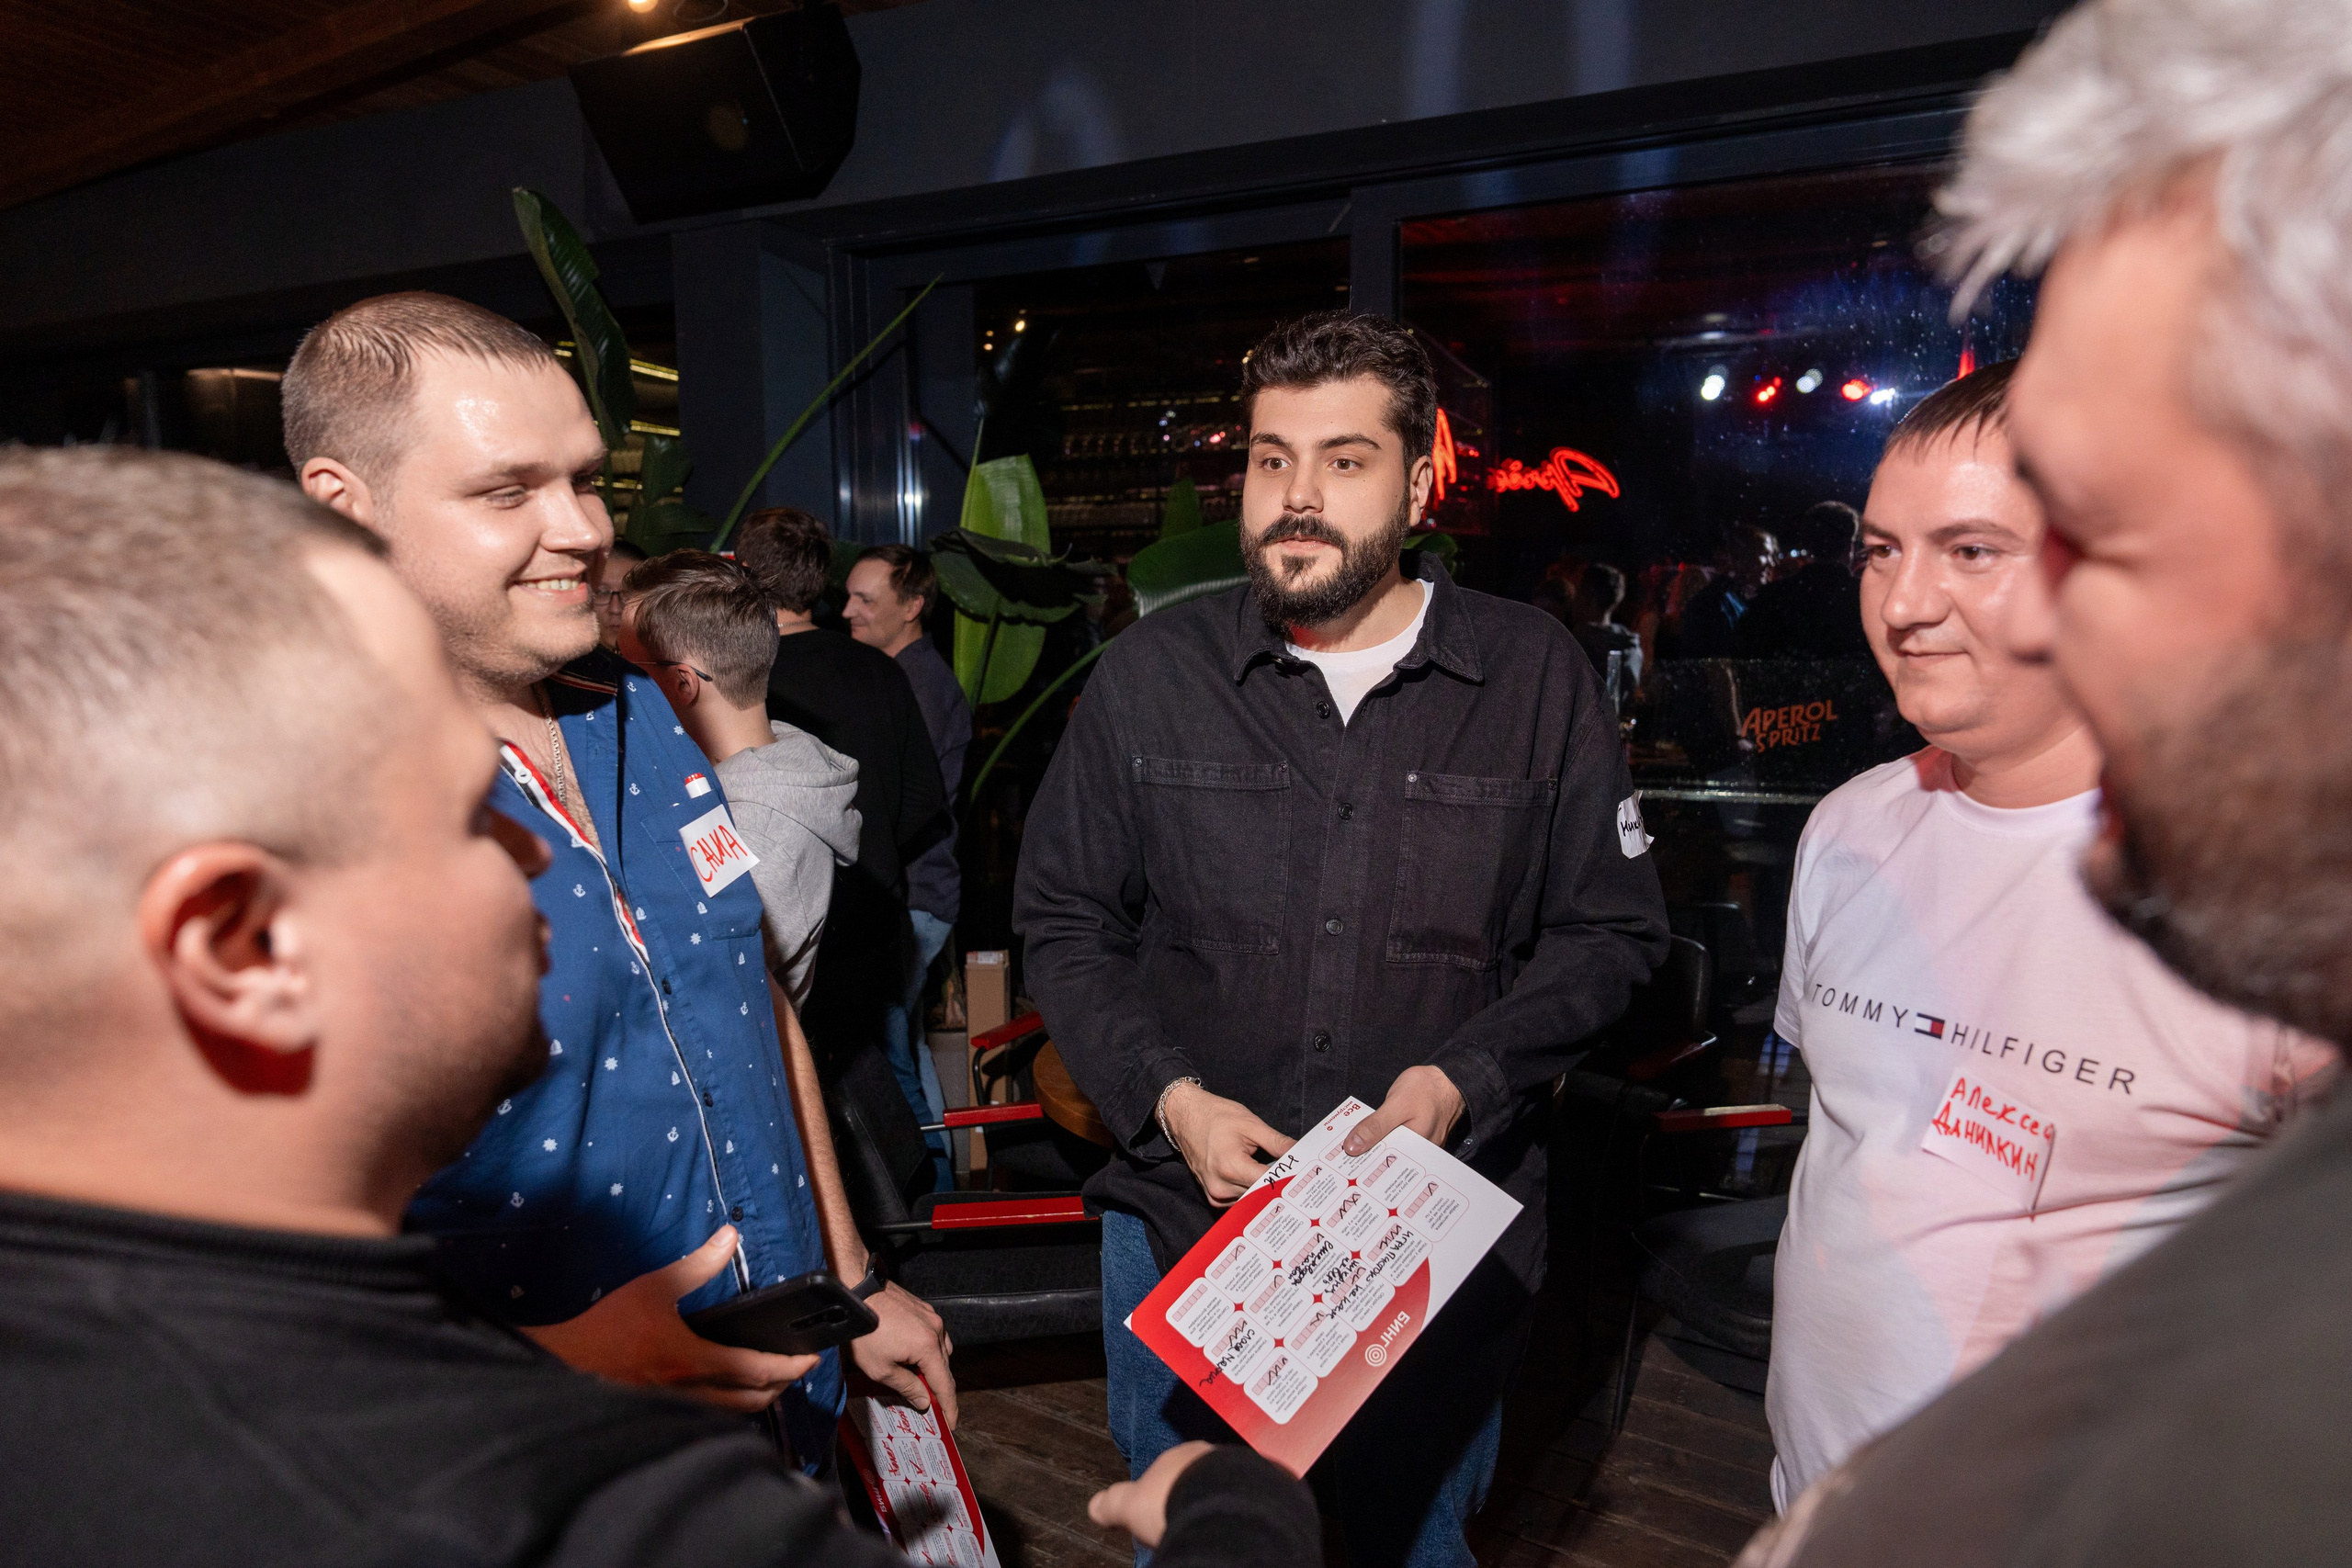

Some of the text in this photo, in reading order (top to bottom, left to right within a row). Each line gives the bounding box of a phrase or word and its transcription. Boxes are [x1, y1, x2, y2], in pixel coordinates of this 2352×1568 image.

[1741, 699, 1838, 737] APEROL
[1756, 722, 1821, 753] SPRITZ
[1811, 983, 2136, 1095] TOMMY HILFIGER
[1343, 1102, 1362, 1118] Все
